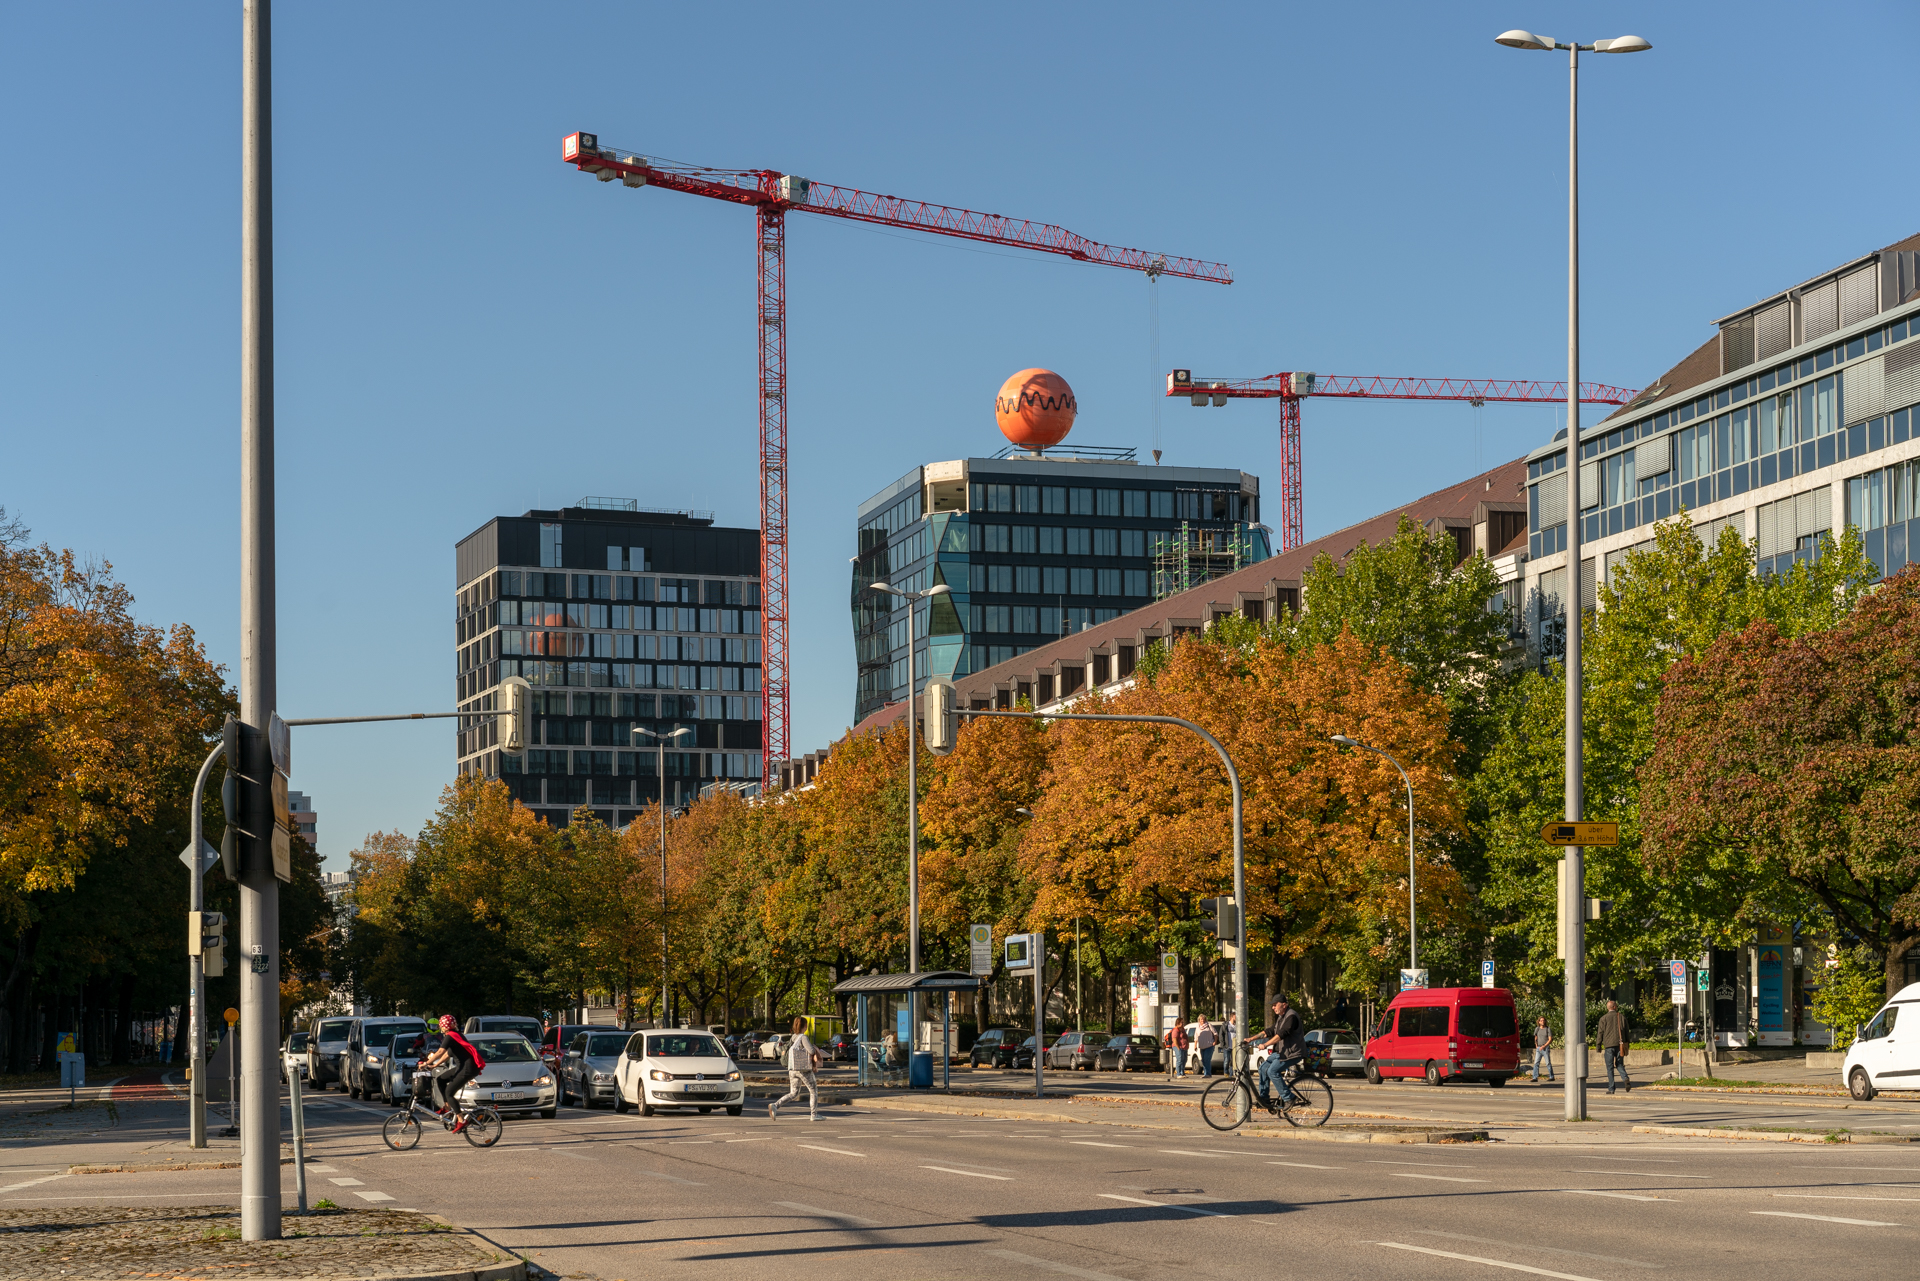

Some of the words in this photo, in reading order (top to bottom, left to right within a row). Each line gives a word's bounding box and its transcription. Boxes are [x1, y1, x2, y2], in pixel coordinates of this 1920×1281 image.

[772, 763, 777, 773] 1
[978, 931, 985, 939] H
[252, 946, 262, 954] 63
[1167, 958, 1173, 966] H
[1484, 963, 1491, 975] P
[1150, 982, 1156, 991] P
